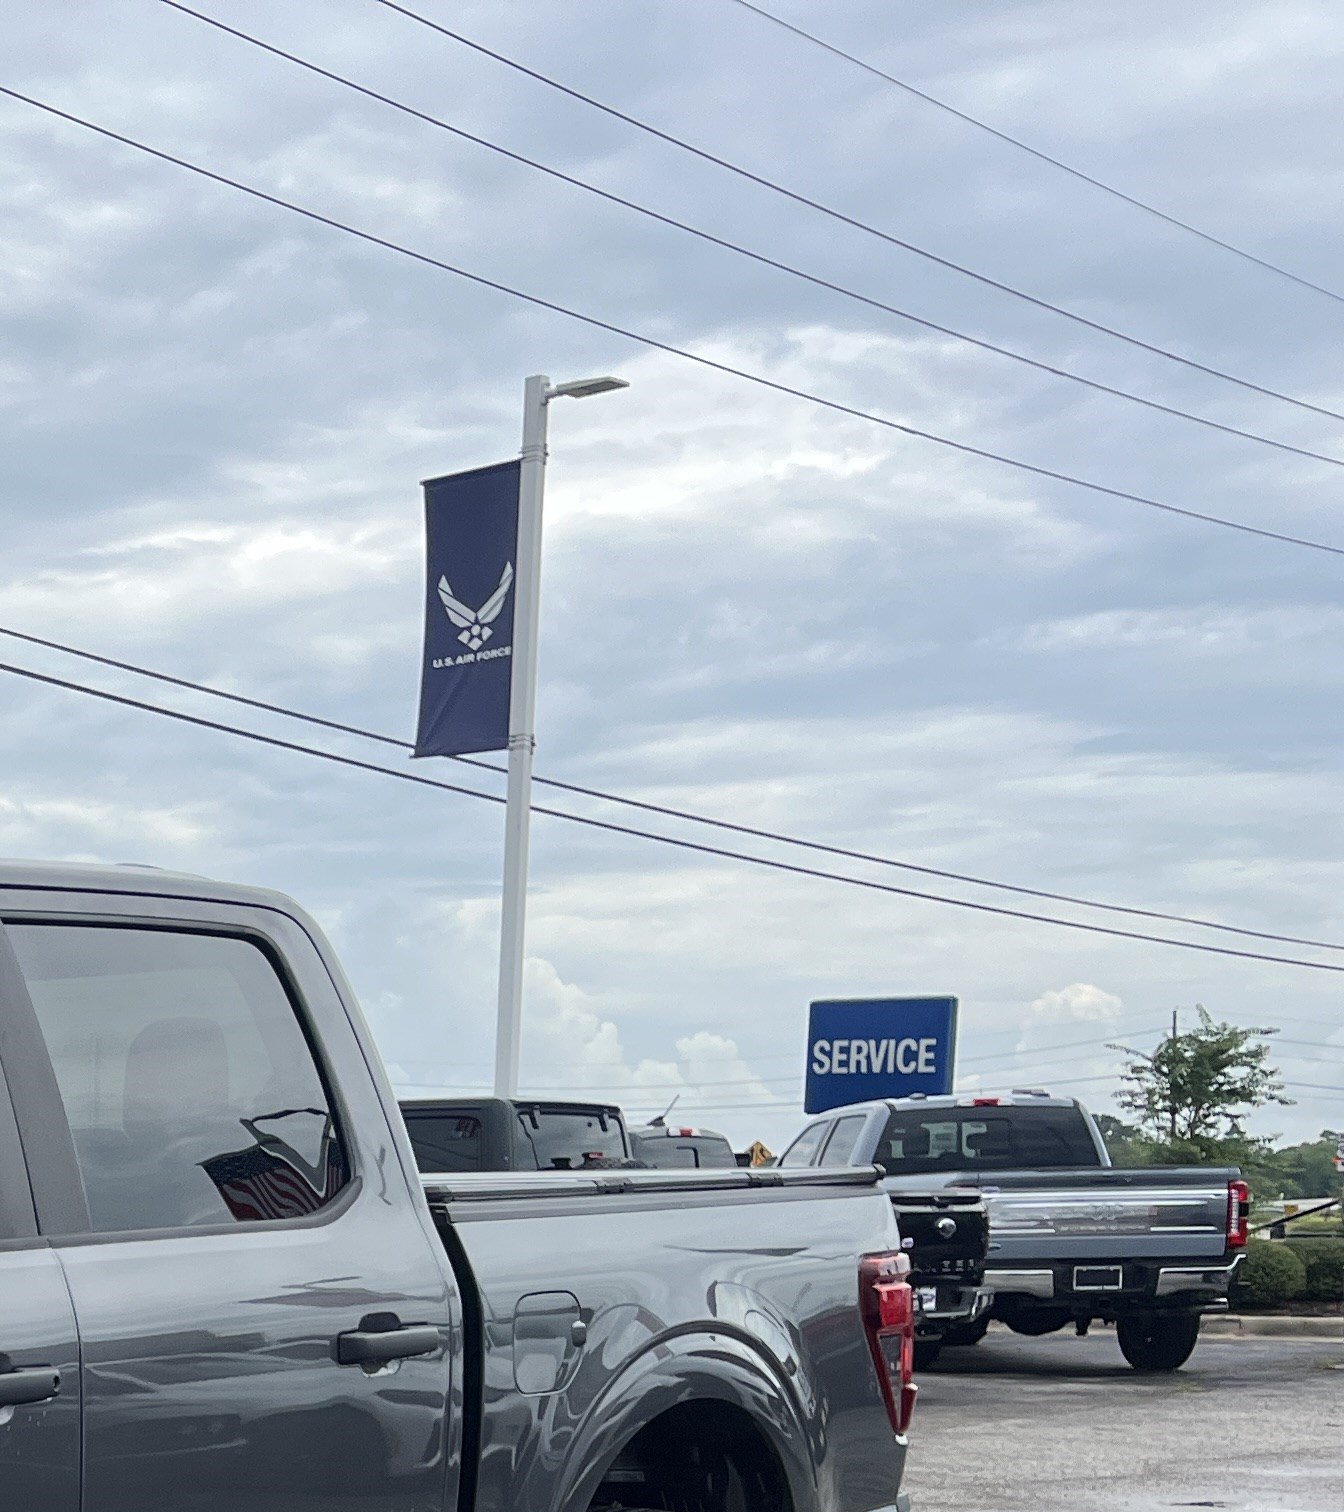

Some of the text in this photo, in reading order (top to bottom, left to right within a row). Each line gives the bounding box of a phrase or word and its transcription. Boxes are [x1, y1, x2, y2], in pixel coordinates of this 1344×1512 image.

[432, 645, 511, 669] U.S. AIR FORCE
[812, 1037, 937, 1075] SERVICE
